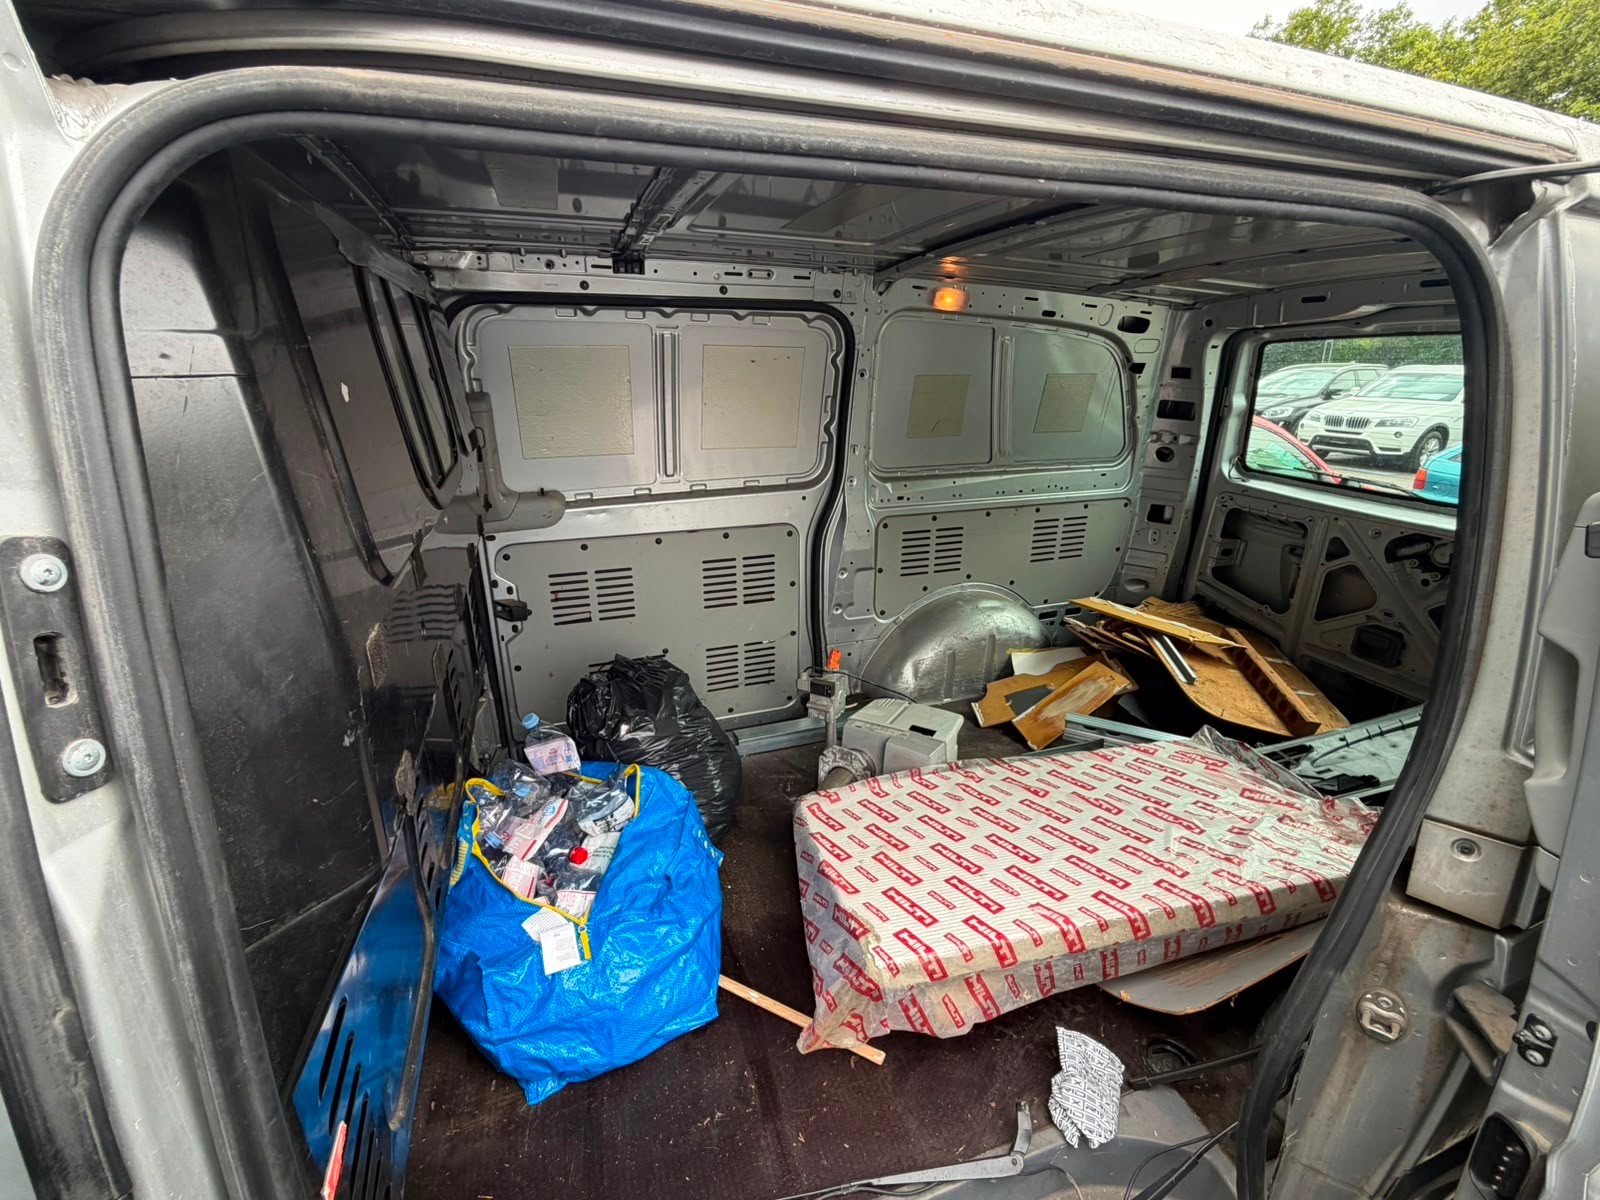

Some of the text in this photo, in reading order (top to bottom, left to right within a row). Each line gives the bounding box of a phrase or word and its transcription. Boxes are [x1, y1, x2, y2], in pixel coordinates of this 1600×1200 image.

[958, 786, 998, 804] HILTI
[1050, 772, 1094, 790] HILTI
[1116, 786, 1170, 806] HILTI
[1166, 778, 1216, 798] HILTI
[810, 804, 844, 830] HILTI
[860, 800, 896, 822] HILTI
[910, 792, 948, 814] HILTI
[1022, 800, 1070, 822] HILTI
[920, 816, 964, 840] HILTI
[974, 808, 1018, 832] HILTI
[1094, 818, 1150, 842] HILTI
[1144, 808, 1204, 834] HILTI
[812, 834, 850, 860] HILTI
[866, 826, 908, 850] HILTI
[988, 836, 1038, 862] HILTI
[1042, 826, 1096, 852] HILTI
[874, 852, 920, 884] HILTI
[932, 844, 982, 874] HILTI
[1066, 856, 1128, 888] HILTI
[1122, 846, 1186, 876] HILTI
[820, 862, 858, 894] HILTI
[1008, 866, 1066, 900] HILTI
[884, 888, 936, 926] HILTI
[946, 878, 1002, 912] HILTI
[1156, 880, 1214, 930] HILTI
[834, 906, 868, 940] HILTI
[1032, 904, 1086, 954] HILTI
[1094, 892, 1150, 940] HILTI
[896, 930, 948, 982] HILTI
[964, 916, 1016, 968] HILTI
[836, 954, 882, 1002] HILTI
[876, 948, 898, 978] HILTI
[944, 996, 964, 1028] HILTI
[966, 974, 998, 1020] HILT
[900, 994, 934, 1036] HIL
